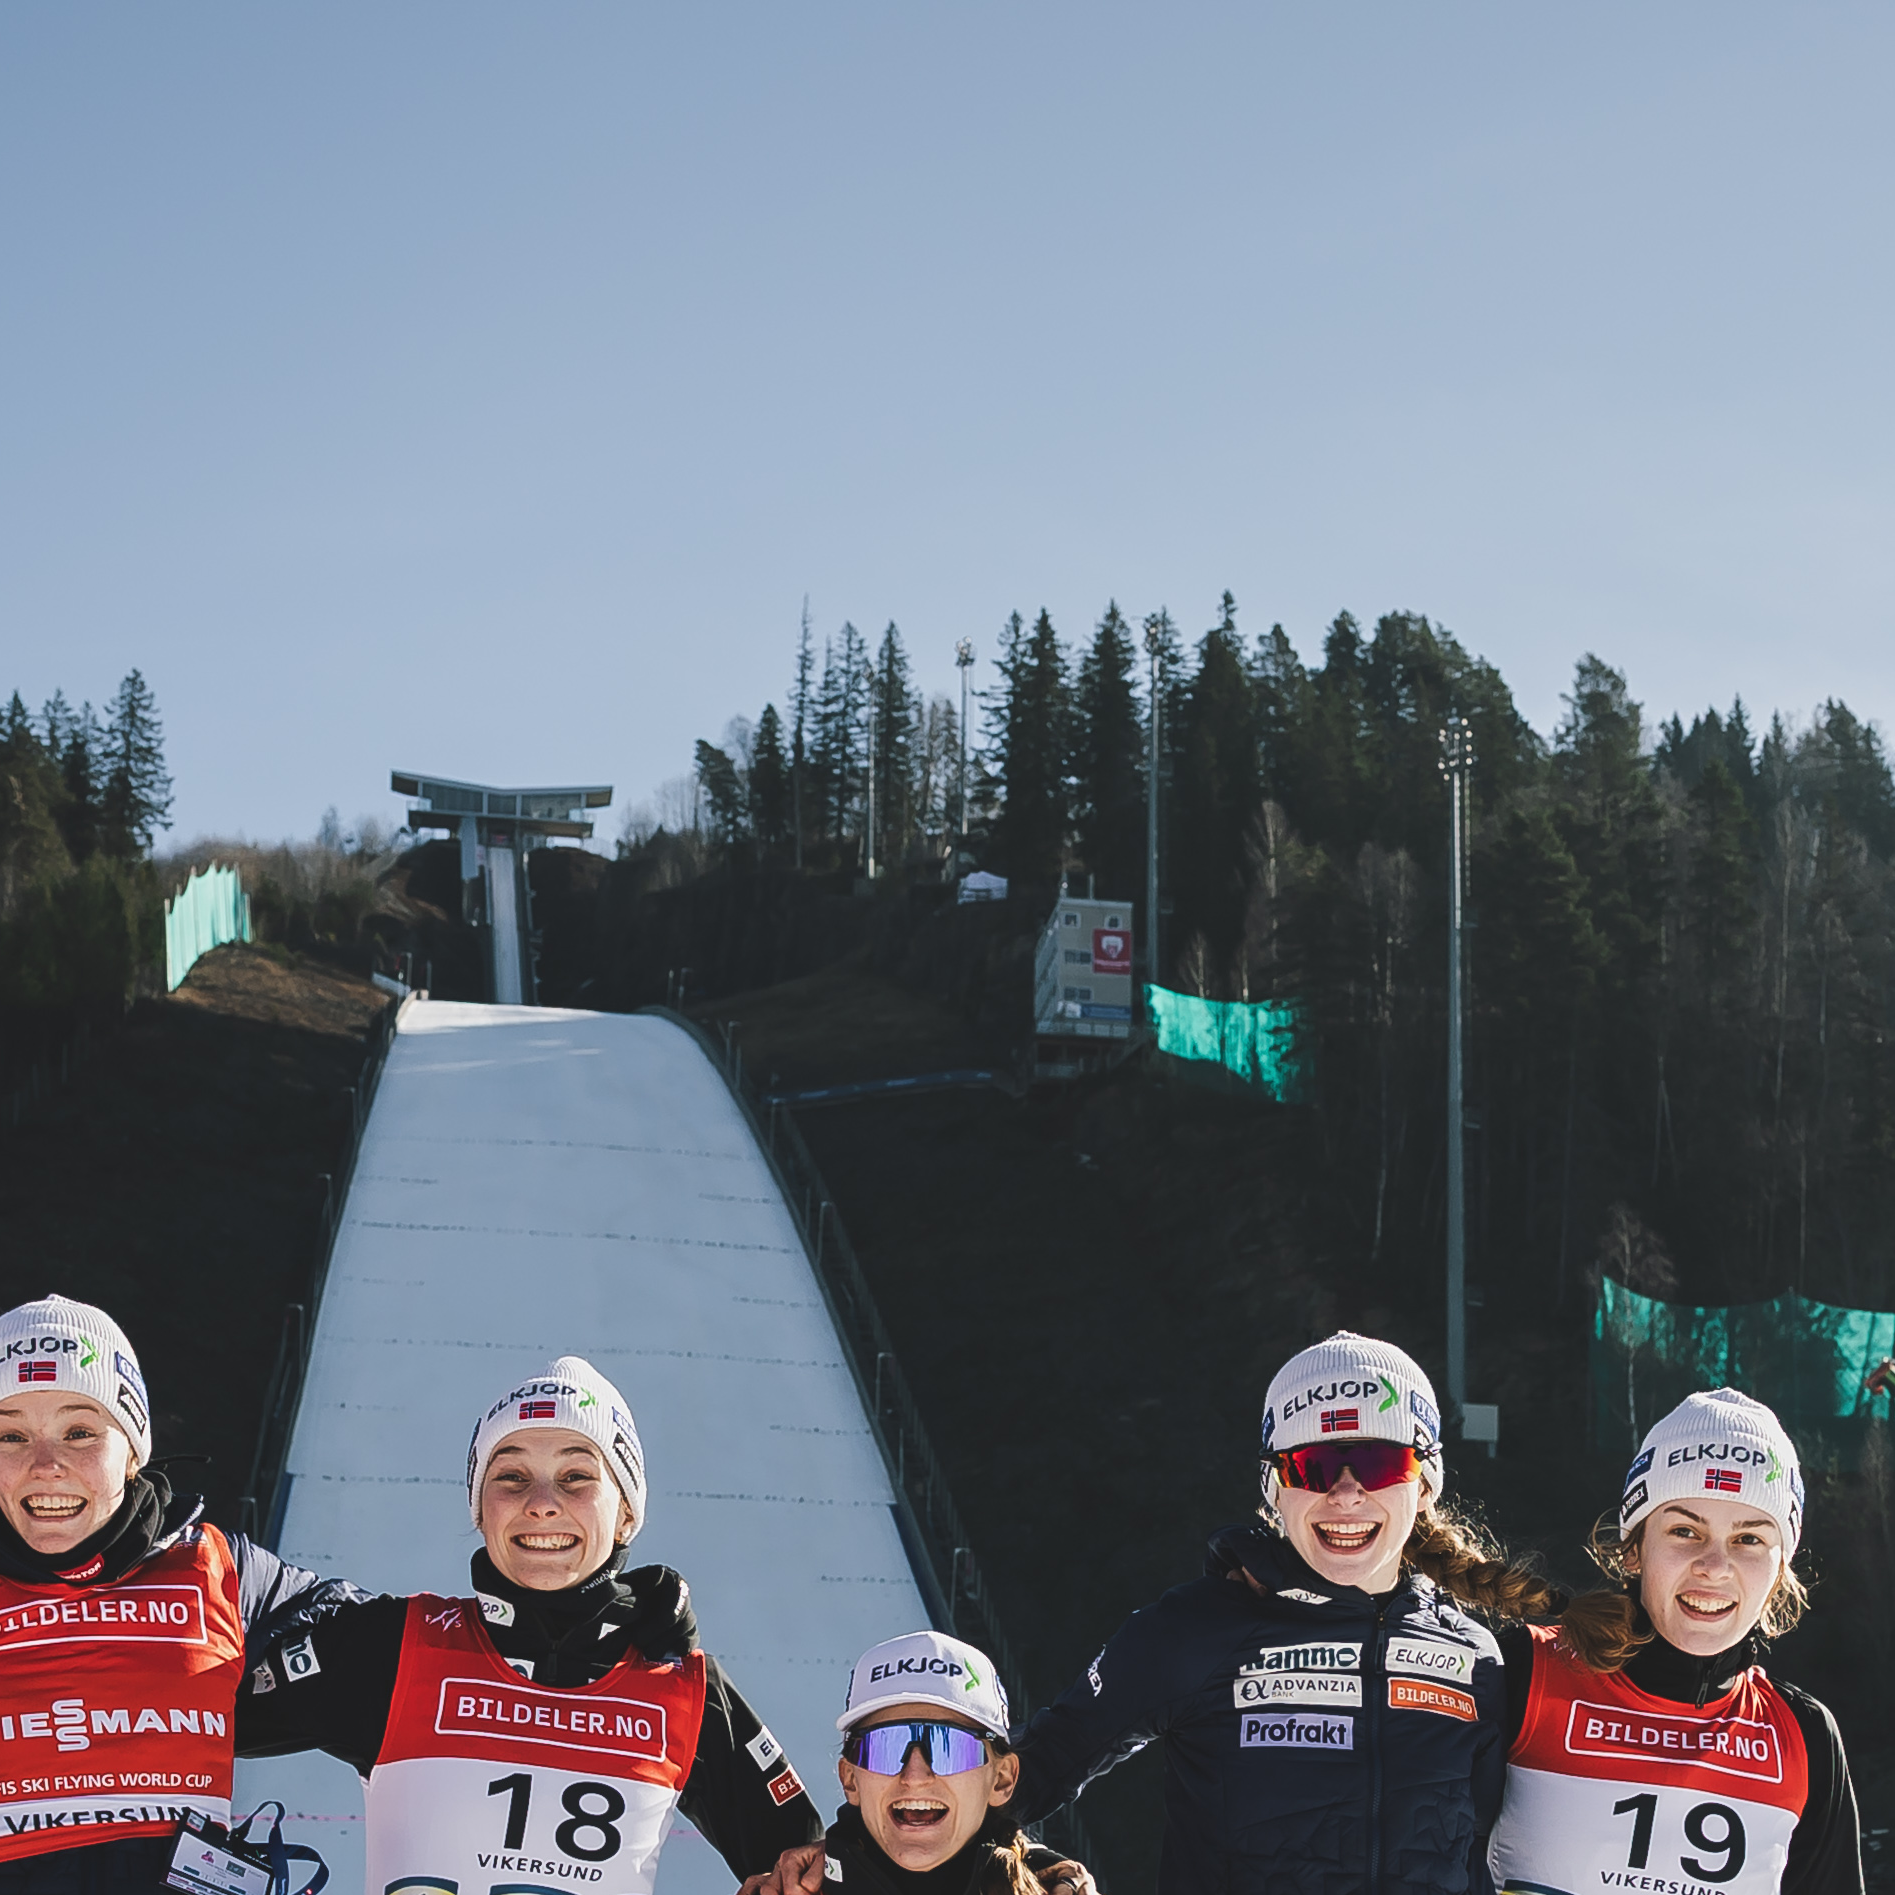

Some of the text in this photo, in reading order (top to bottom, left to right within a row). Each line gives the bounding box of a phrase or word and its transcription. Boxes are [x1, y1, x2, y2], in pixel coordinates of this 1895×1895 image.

[1272, 1678, 1356, 1693] ADVANZIA
[1396, 1686, 1473, 1715] BILDELER.NO
[457, 1696, 652, 1741] BILDELER.NO
[1246, 1718, 1347, 1745] Profrakt
[1585, 1718, 1769, 1762] BILDELER.NO
[22, 1777, 50, 1793] SKI
[54, 1773, 115, 1791] FLYING
[119, 1772, 182, 1788] WORLD
[185, 1773, 213, 1789] CUP
[487, 1772, 626, 1862] 18
[1612, 1793, 1747, 1884] 19
[477, 1853, 604, 1882] VIKERSUND
